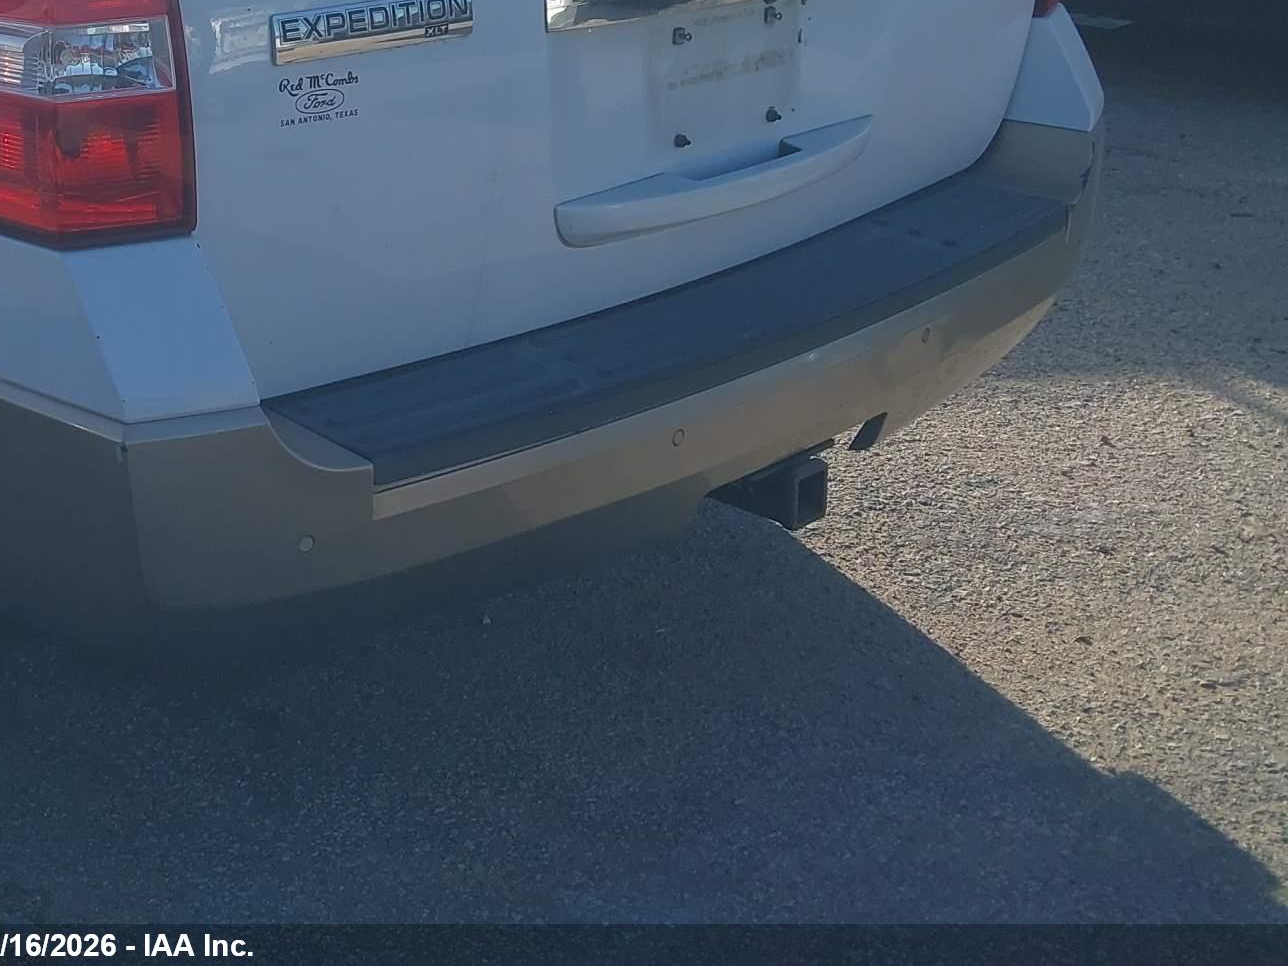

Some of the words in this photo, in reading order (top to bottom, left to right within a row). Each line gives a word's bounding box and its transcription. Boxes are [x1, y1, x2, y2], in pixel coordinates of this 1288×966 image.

[426, 25, 448, 37] XLT
[279, 77, 304, 97] Red
[303, 92, 337, 109] Ford
[280, 118, 296, 128] SAN
[297, 113, 333, 125] ANTONIO,
[335, 108, 359, 119] TEXAS
